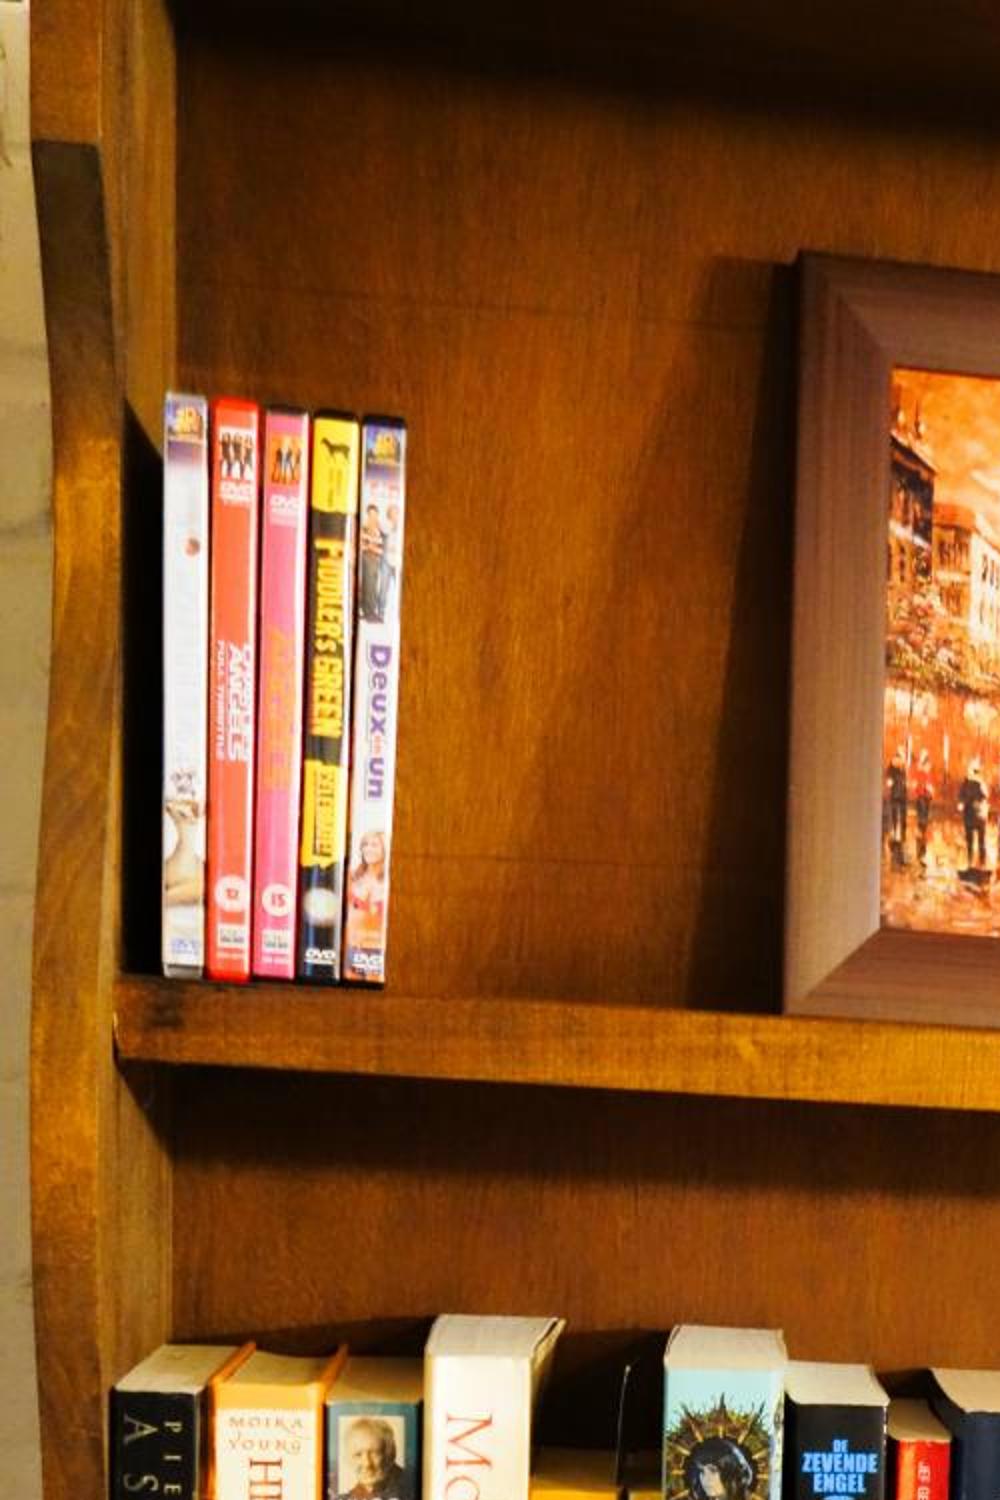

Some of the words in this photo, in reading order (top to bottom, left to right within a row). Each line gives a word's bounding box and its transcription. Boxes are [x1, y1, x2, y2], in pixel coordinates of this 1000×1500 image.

[310, 656, 344, 738] GREEN
[367, 644, 392, 736] Deux
[366, 757, 387, 801] un
[832, 1439, 849, 1453] DE
[801, 1452, 879, 1473] ZEVENDE
[917, 1461, 931, 1482] JEF
[813, 1473, 867, 1493] ENGEL
